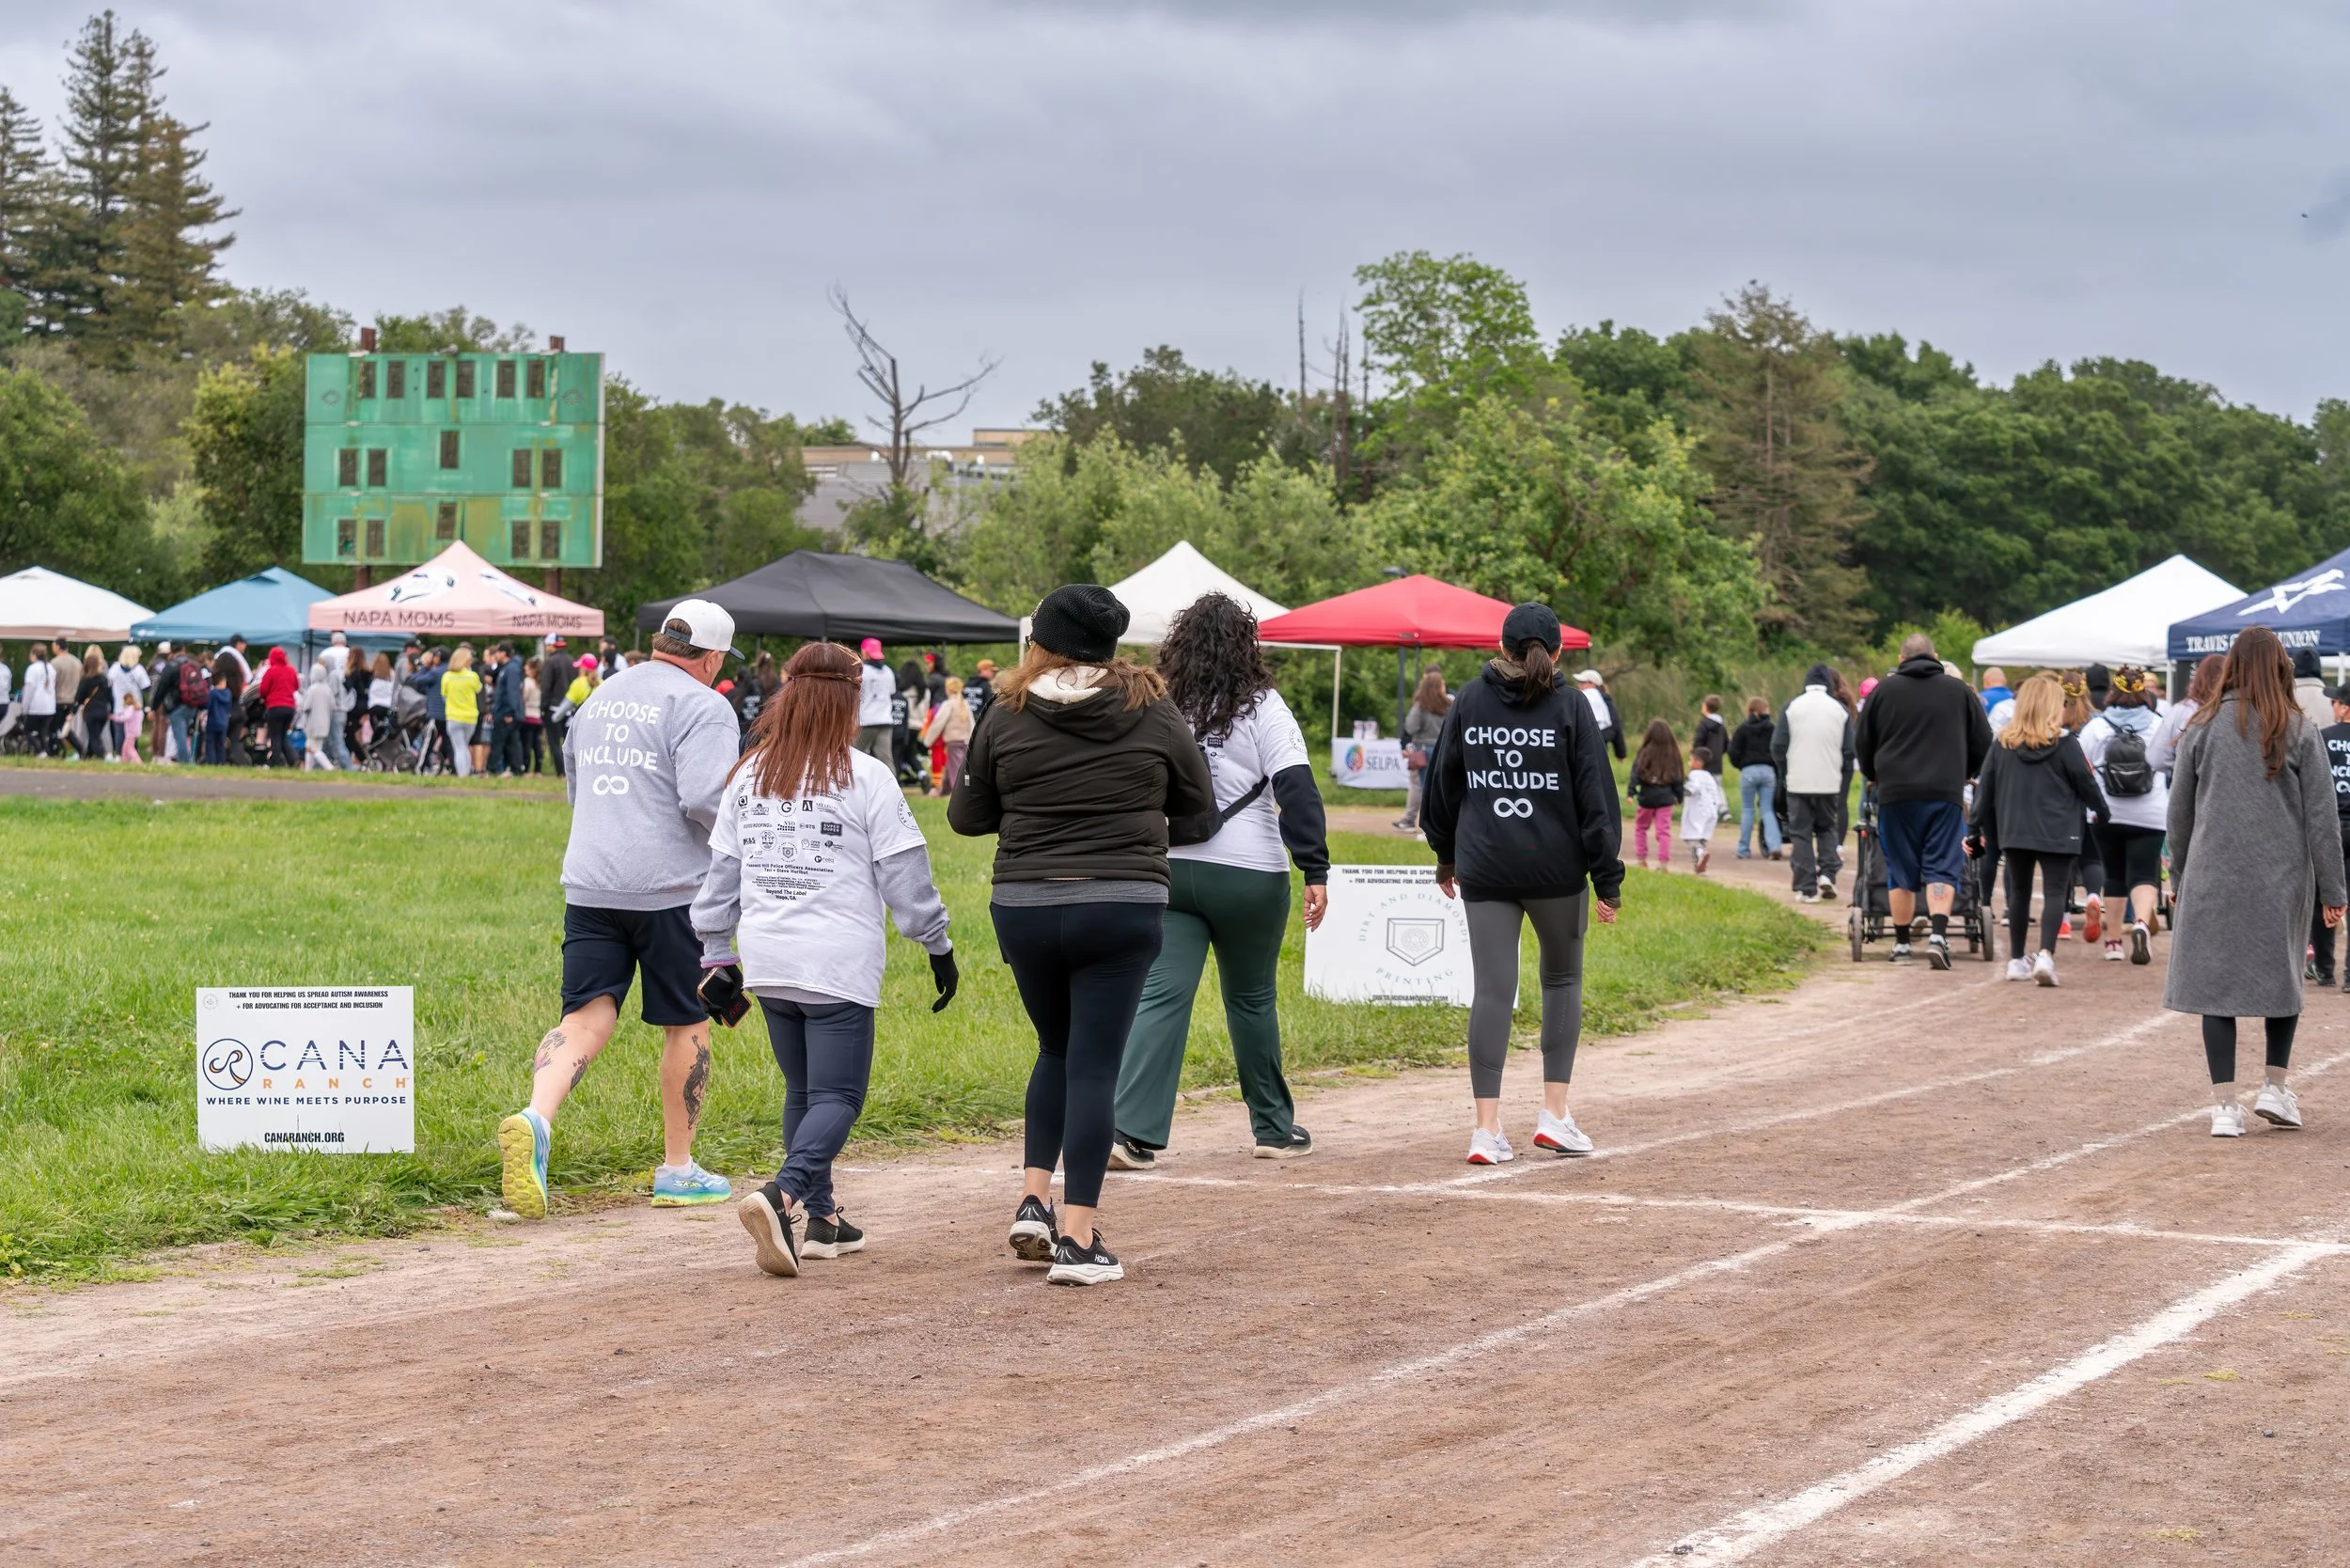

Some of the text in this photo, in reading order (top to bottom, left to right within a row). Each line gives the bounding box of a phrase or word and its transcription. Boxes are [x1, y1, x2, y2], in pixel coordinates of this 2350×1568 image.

[343, 611, 455, 628] NAPA MOMS
[512, 615, 582, 630] NAPA MOMS
[2186, 634, 2229, 652] TRAVIS
[588, 700, 662, 724] CHOOSE
[604, 723, 629, 743] TO
[1465, 727, 1556, 747] CHOOSE
[579, 745, 658, 771] INCLUDE
[1366, 756, 1401, 771] SELPA
[1494, 749, 1523, 768] TO
[1467, 771, 1559, 791] INCLUDE
[1359, 893, 1469, 944] DIRT AND DIAMONDS
[1375, 967, 1454, 986] PRINTING
[259, 1039, 409, 1071] CANA
[262, 1077, 406, 1090] RANCH
[206, 1096, 407, 1105] WHERE WINE MEETS PURPOSE
[264, 1131, 345, 1143] CANARANCH.ORG
[1094, 1253, 1110, 1264] HOKA
